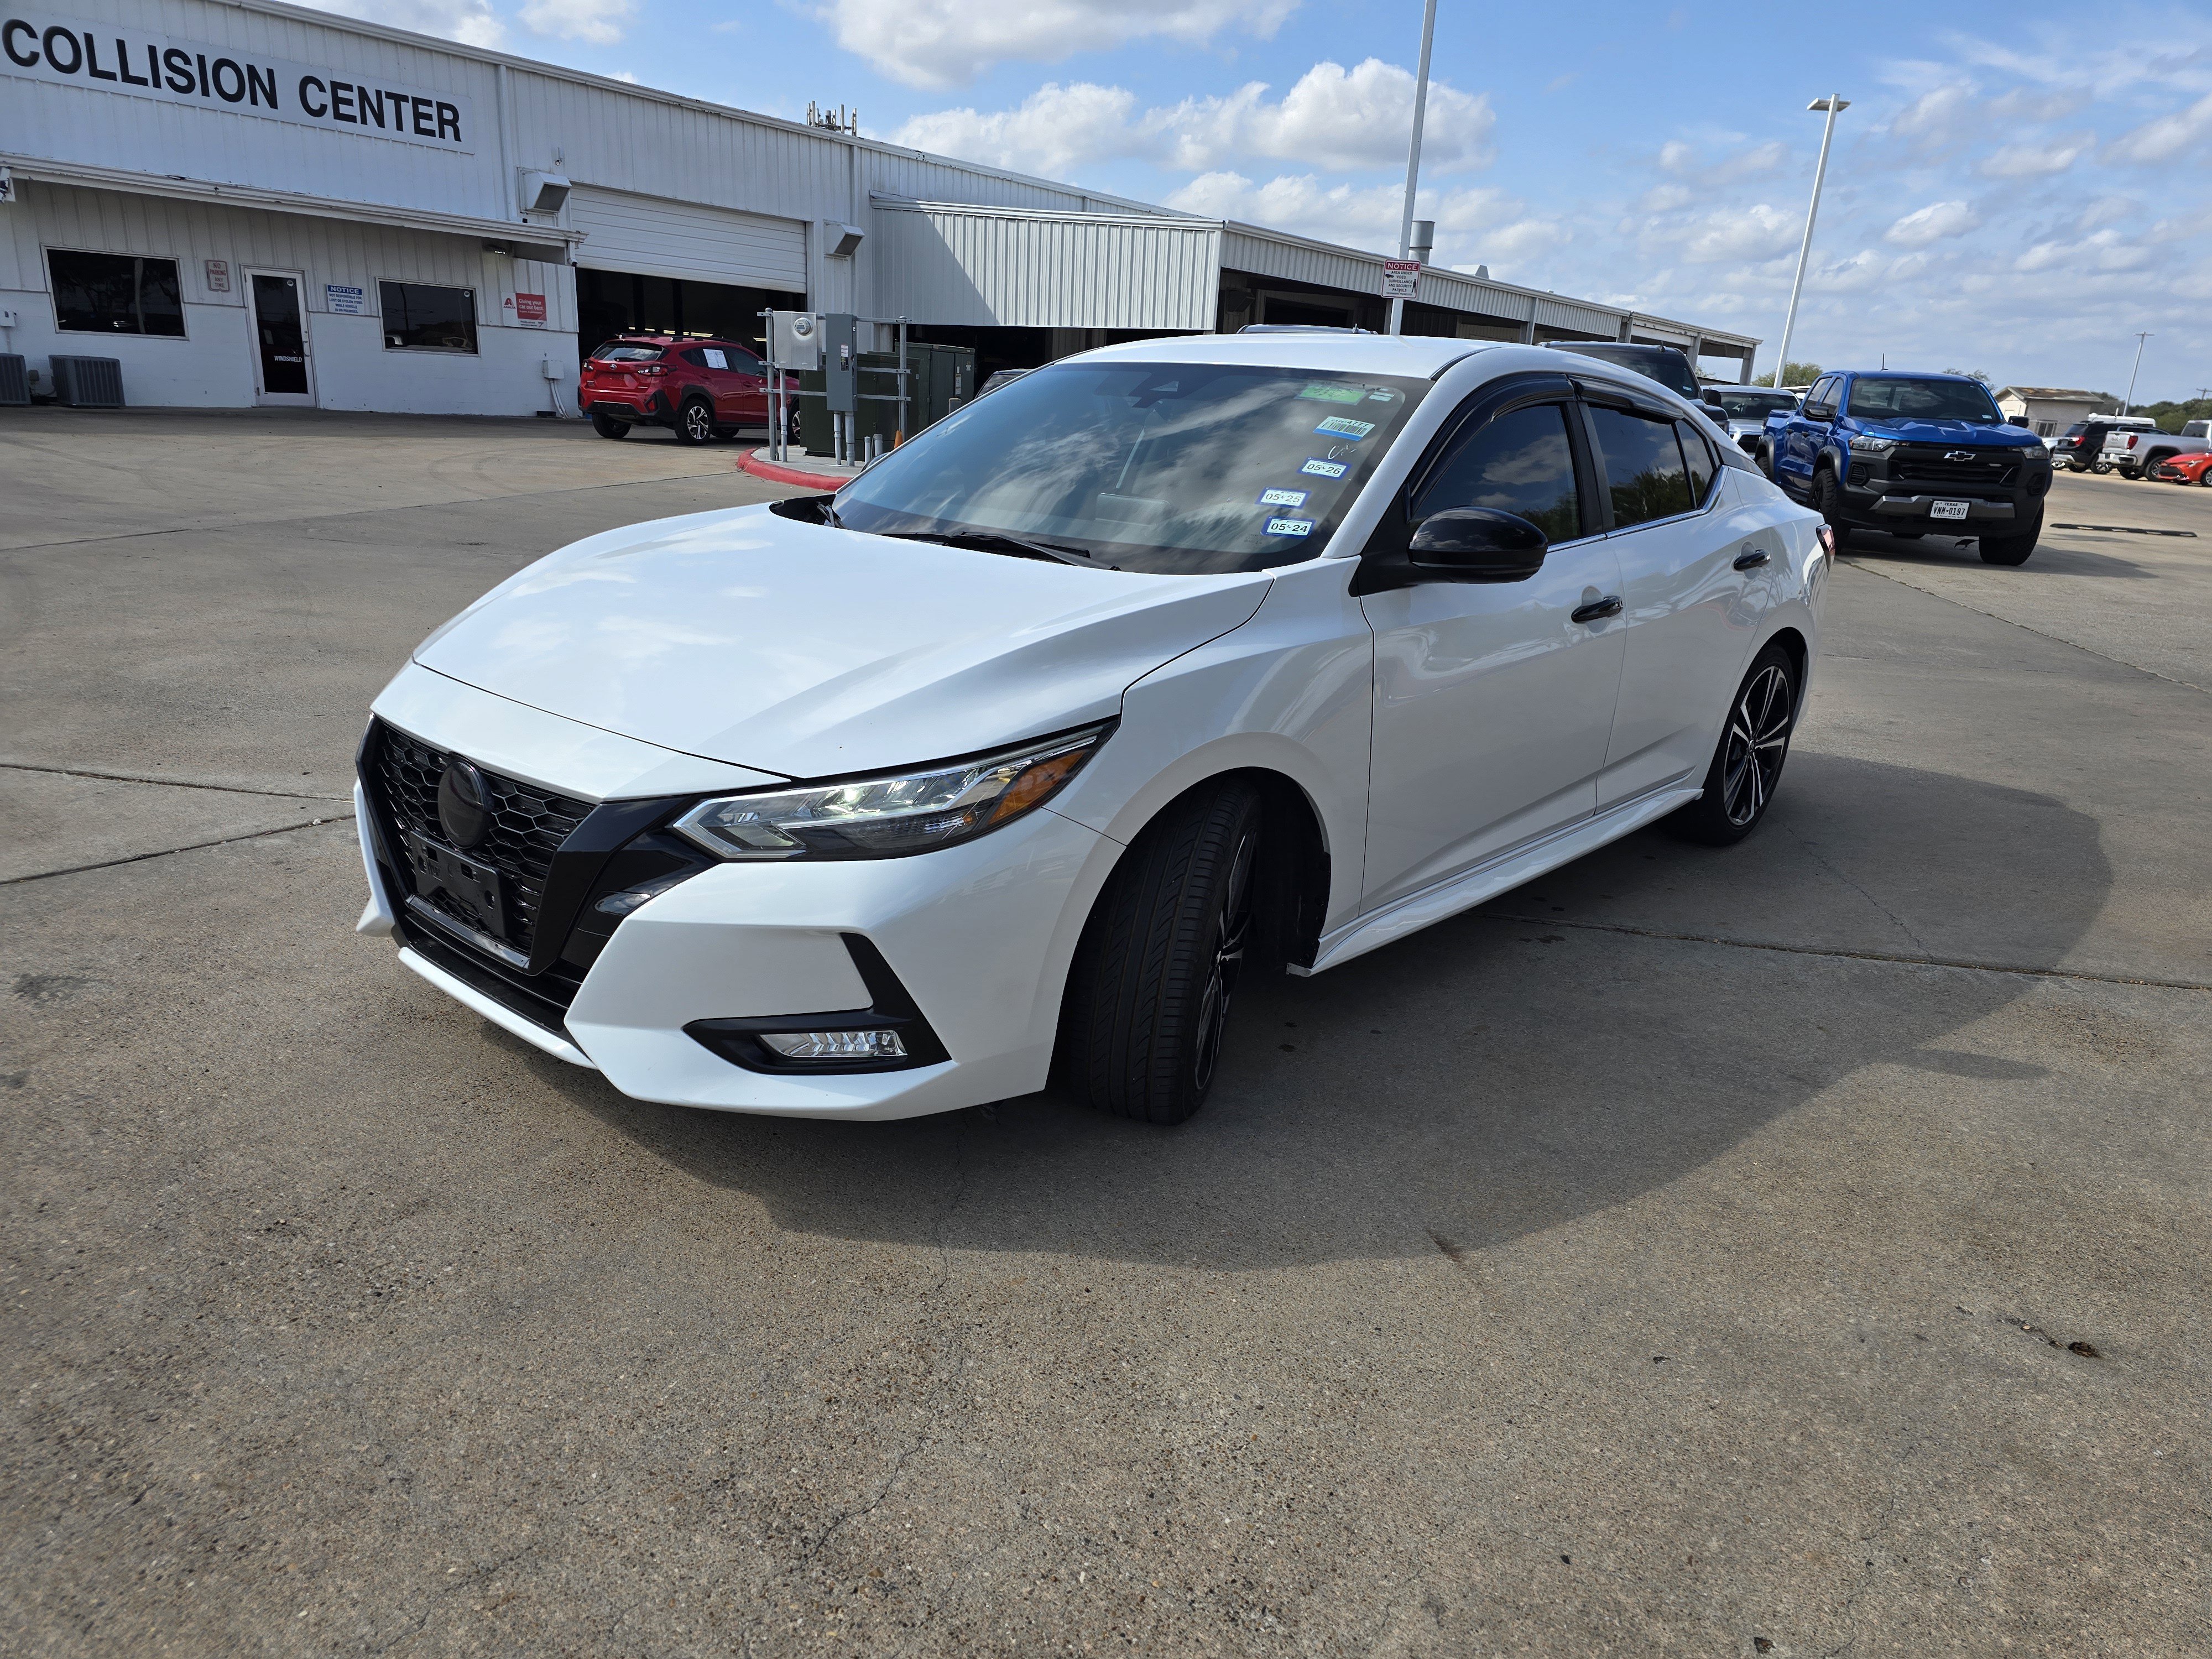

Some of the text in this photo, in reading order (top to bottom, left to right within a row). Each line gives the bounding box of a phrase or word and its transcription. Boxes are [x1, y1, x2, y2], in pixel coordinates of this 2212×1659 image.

[2, 18, 462, 142] COLLISION CENTER
[1292, 524, 1308, 533] 24
